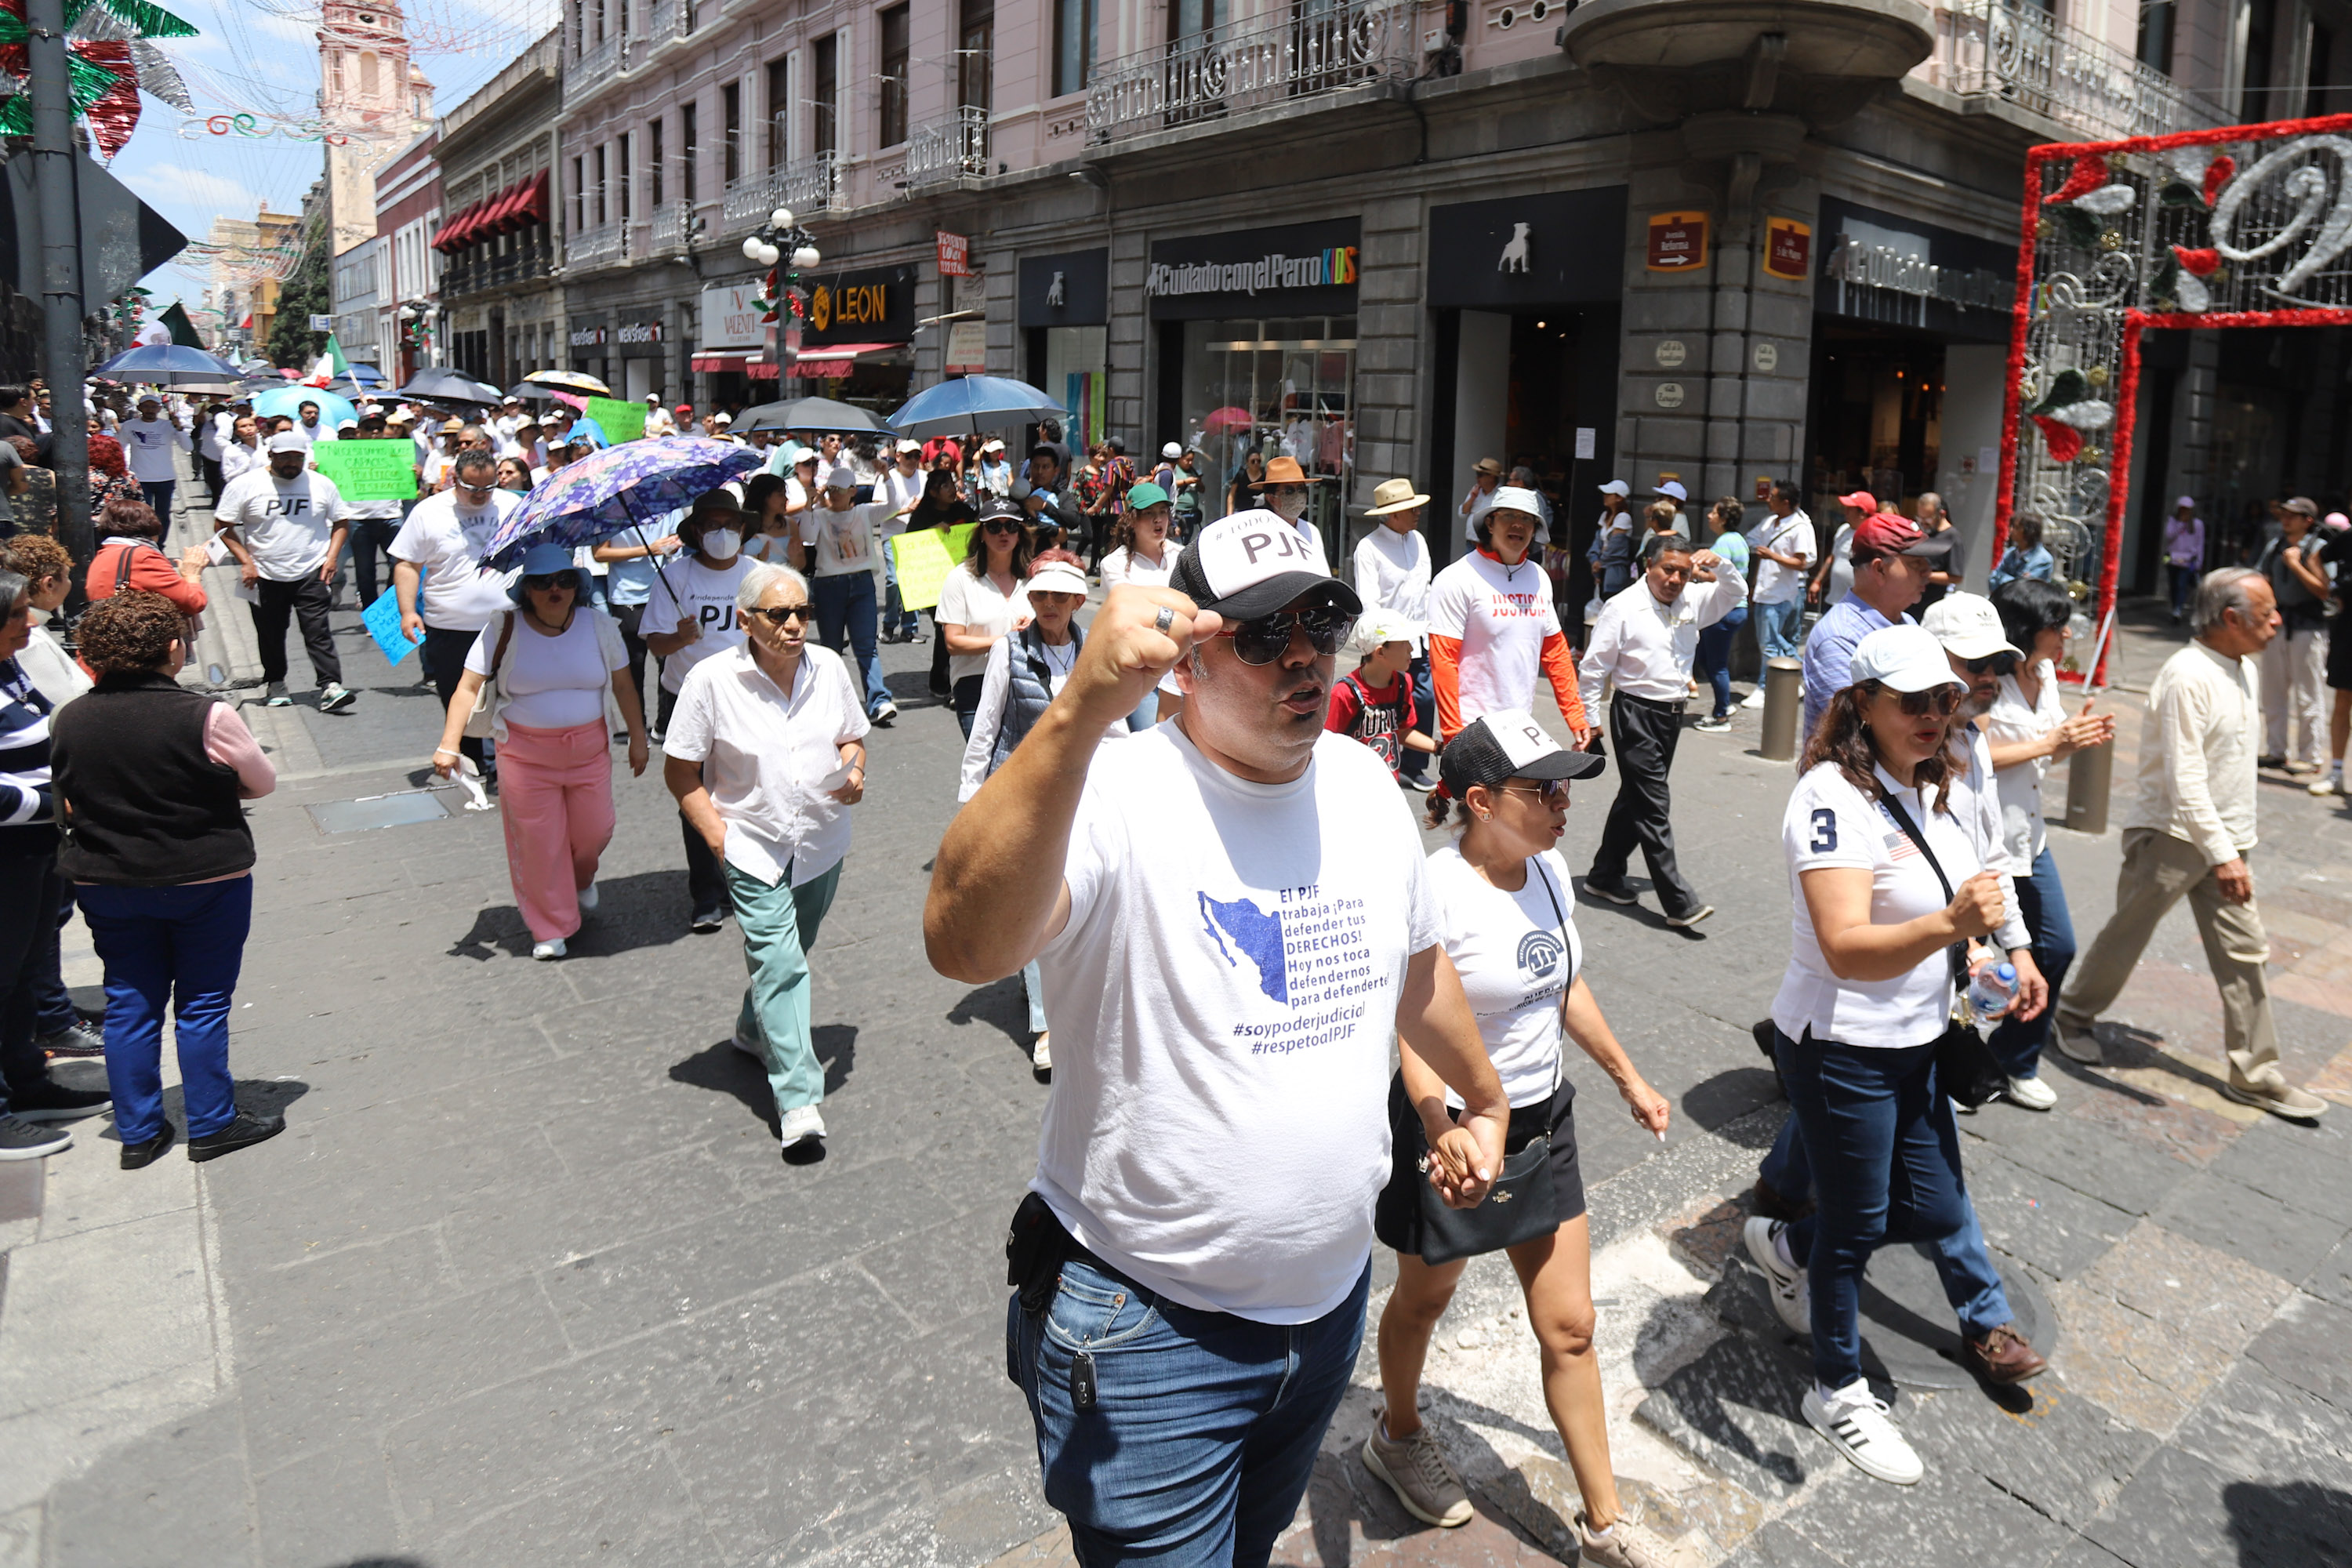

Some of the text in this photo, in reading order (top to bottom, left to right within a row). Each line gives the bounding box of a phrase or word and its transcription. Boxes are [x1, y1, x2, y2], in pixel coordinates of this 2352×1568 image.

[1661, 241, 1690, 252] Reforma
[836, 283, 887, 324] LEON
[265, 499, 310, 516] PJF
[1240, 531, 1312, 565] PJF
[699, 604, 741, 632] PJ
[1810, 808, 1838, 855] 3
[1279, 884, 1320, 903] El PJF
[1283, 903, 1330, 920] trabaja
[1284, 913, 1367, 938] defender tus
[1287, 930, 1363, 955] DERECHOS!
[1288, 949, 1370, 973] Hoy nos toca
[1289, 964, 1371, 991] defendernos
[1290, 993, 1321, 1011] para
[1232, 1000, 1366, 1039] #soypoderjudicial
[1251, 1023, 1356, 1055] #respetoalPJF
